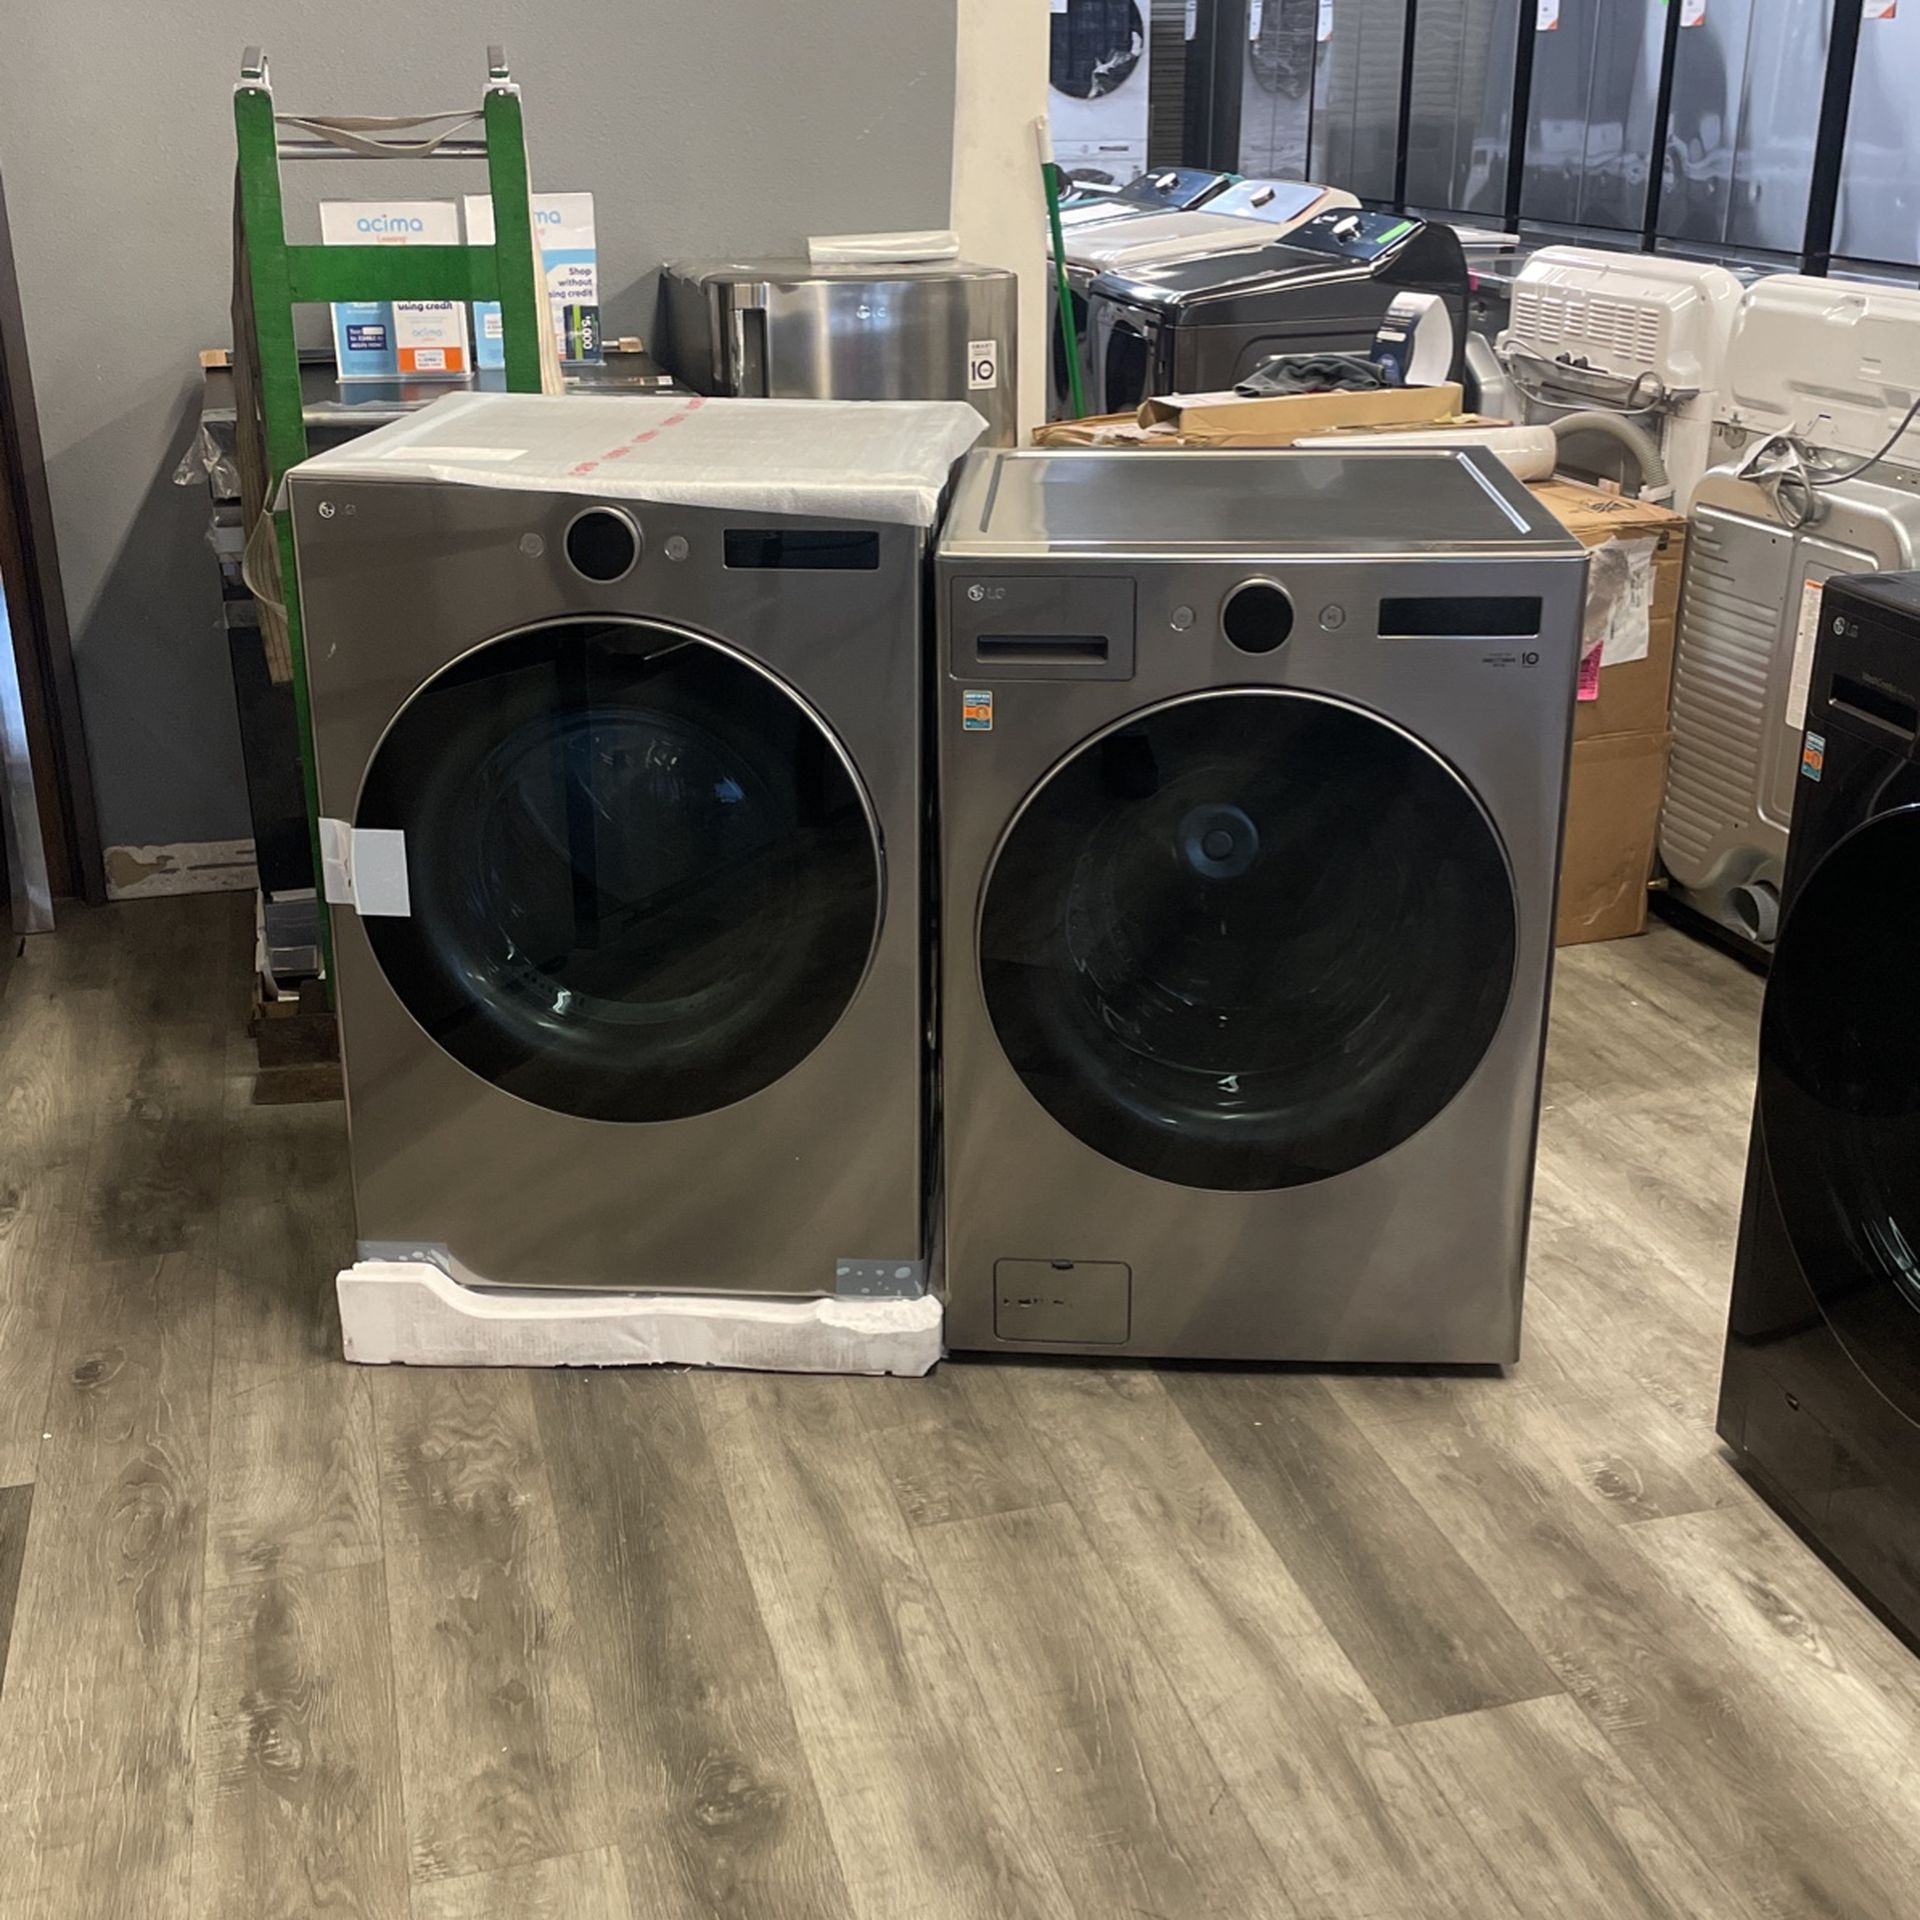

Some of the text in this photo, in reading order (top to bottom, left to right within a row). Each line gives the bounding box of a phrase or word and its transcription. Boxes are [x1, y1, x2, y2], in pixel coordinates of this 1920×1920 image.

[357, 214, 423, 232] acima
[569, 267, 592, 276] Shop
[558, 278, 592, 286] without
[548, 289, 593, 298] sing credit
[398, 302, 424, 311] using
[971, 360, 994, 381] 10
[1521, 651, 1539, 665] 10
